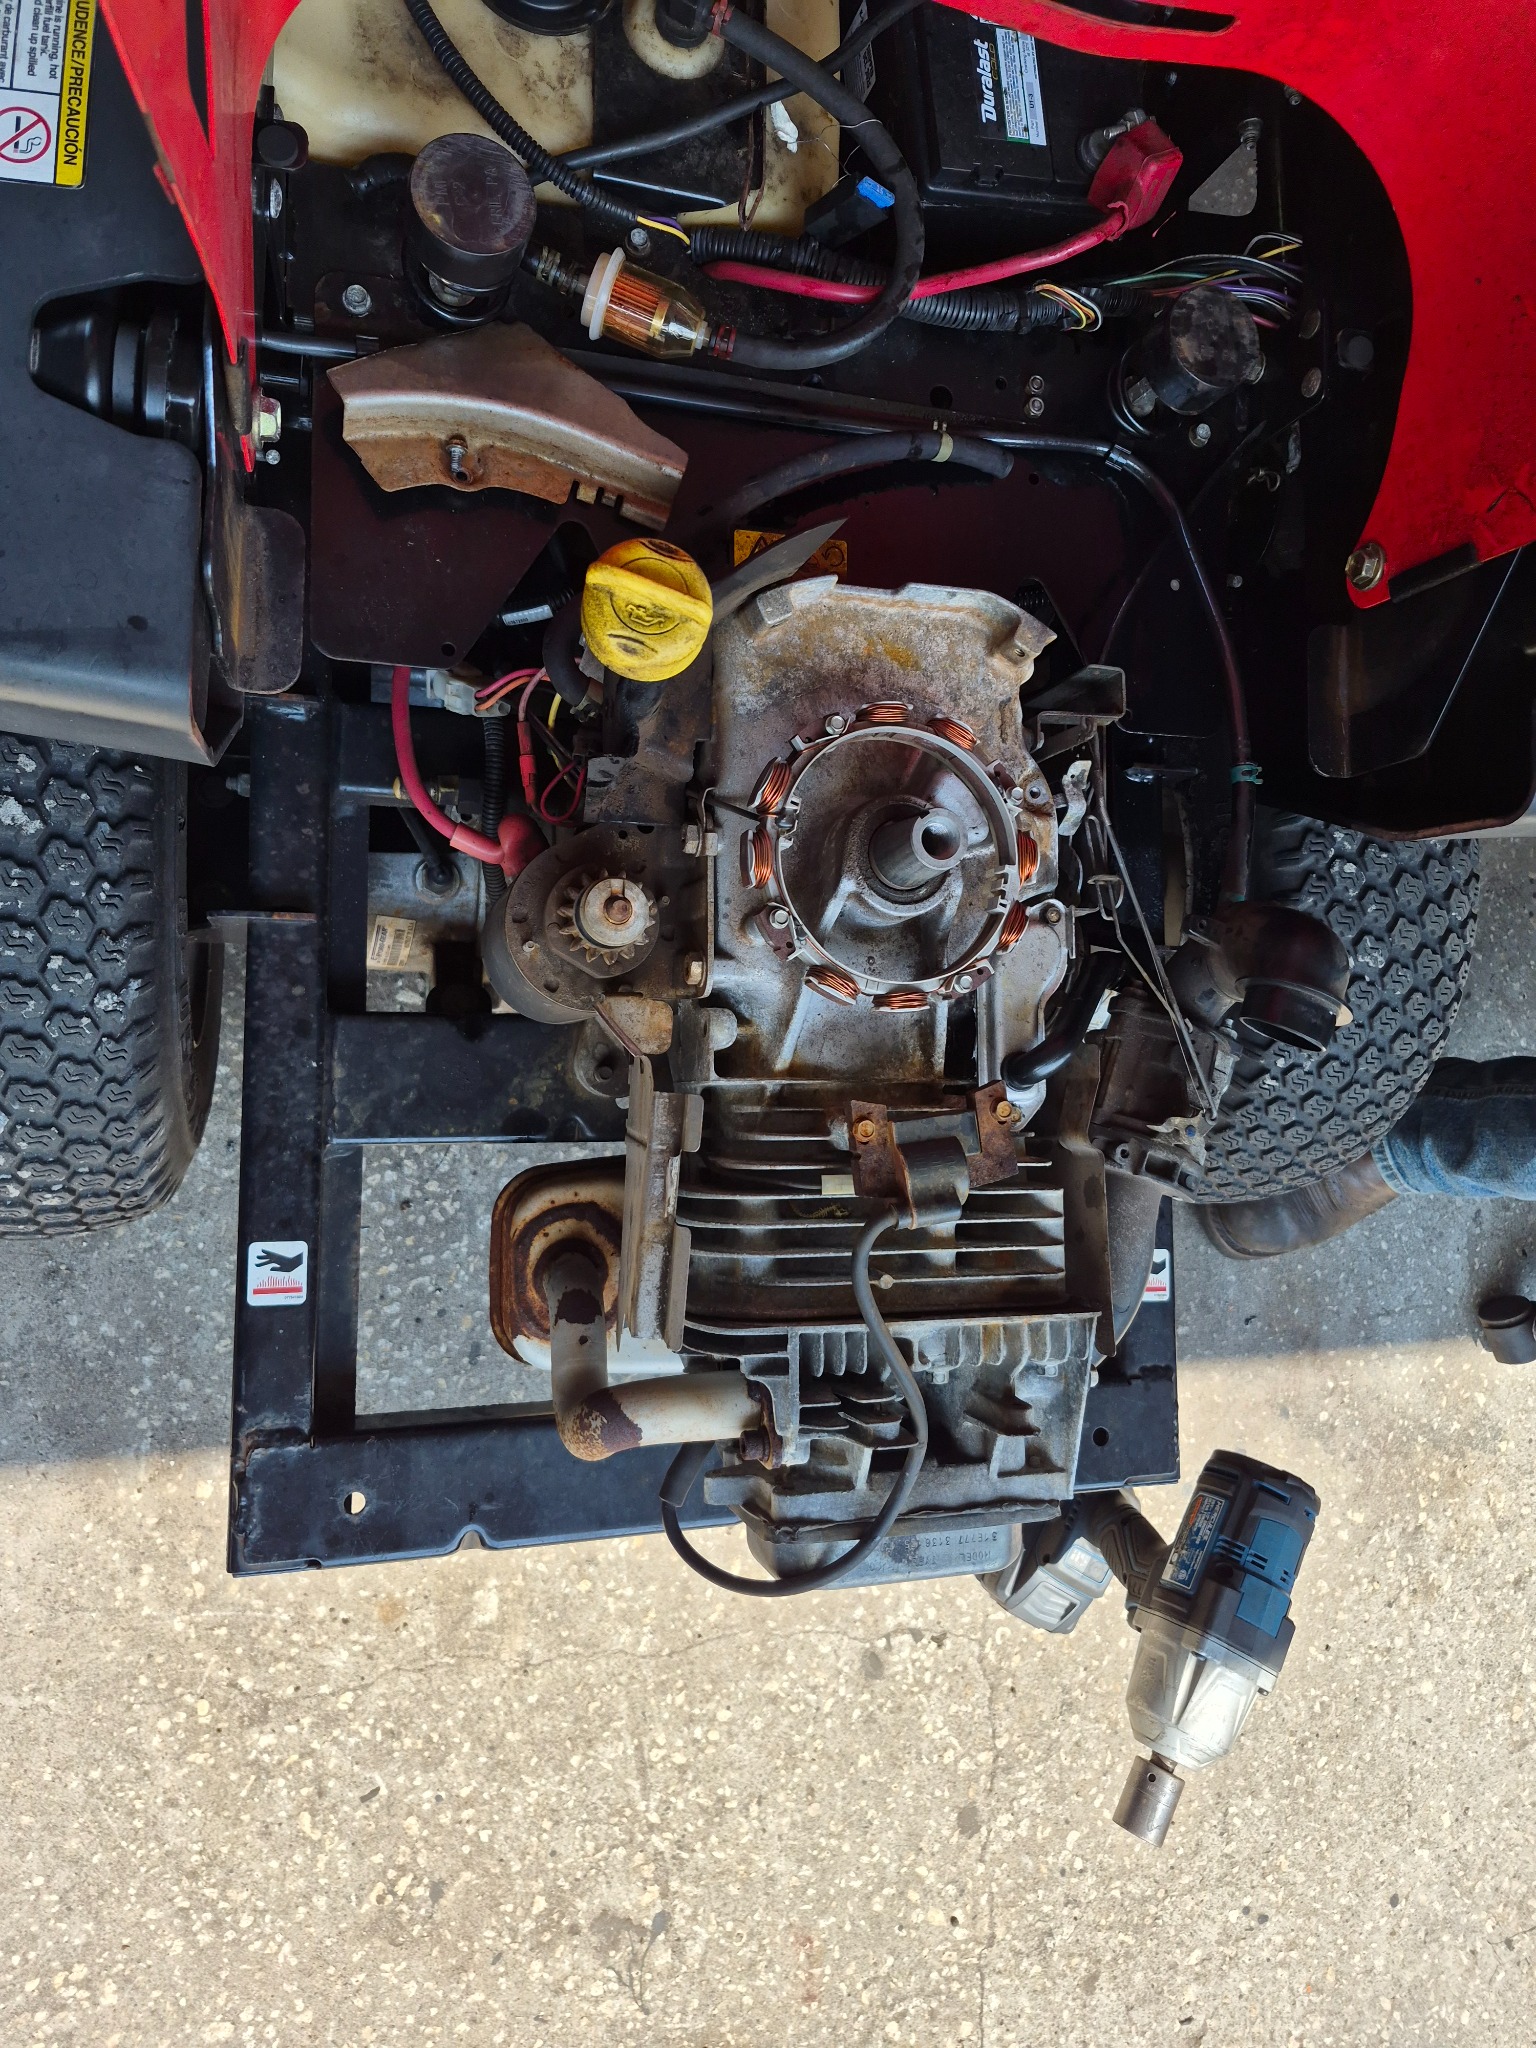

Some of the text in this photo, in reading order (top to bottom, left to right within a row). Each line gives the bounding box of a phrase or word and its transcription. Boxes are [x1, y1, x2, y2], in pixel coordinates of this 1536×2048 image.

[4, 4, 14, 15] de
[32, 8, 43, 31] clean
[54, 15, 65, 23] is
[42, 17, 53, 34] fuel
[0, 17, 11, 60] carburant
[28, 33, 38, 45] up
[40, 35, 50, 56] tank.
[48, 25, 61, 62] running,
[27, 47, 38, 77] spilled
[49, 64, 60, 80] hot
[988, 43, 998, 80] GOLD
[973, 38, 997, 123] Duralast
[1027, 93, 1035, 109] U1-3
